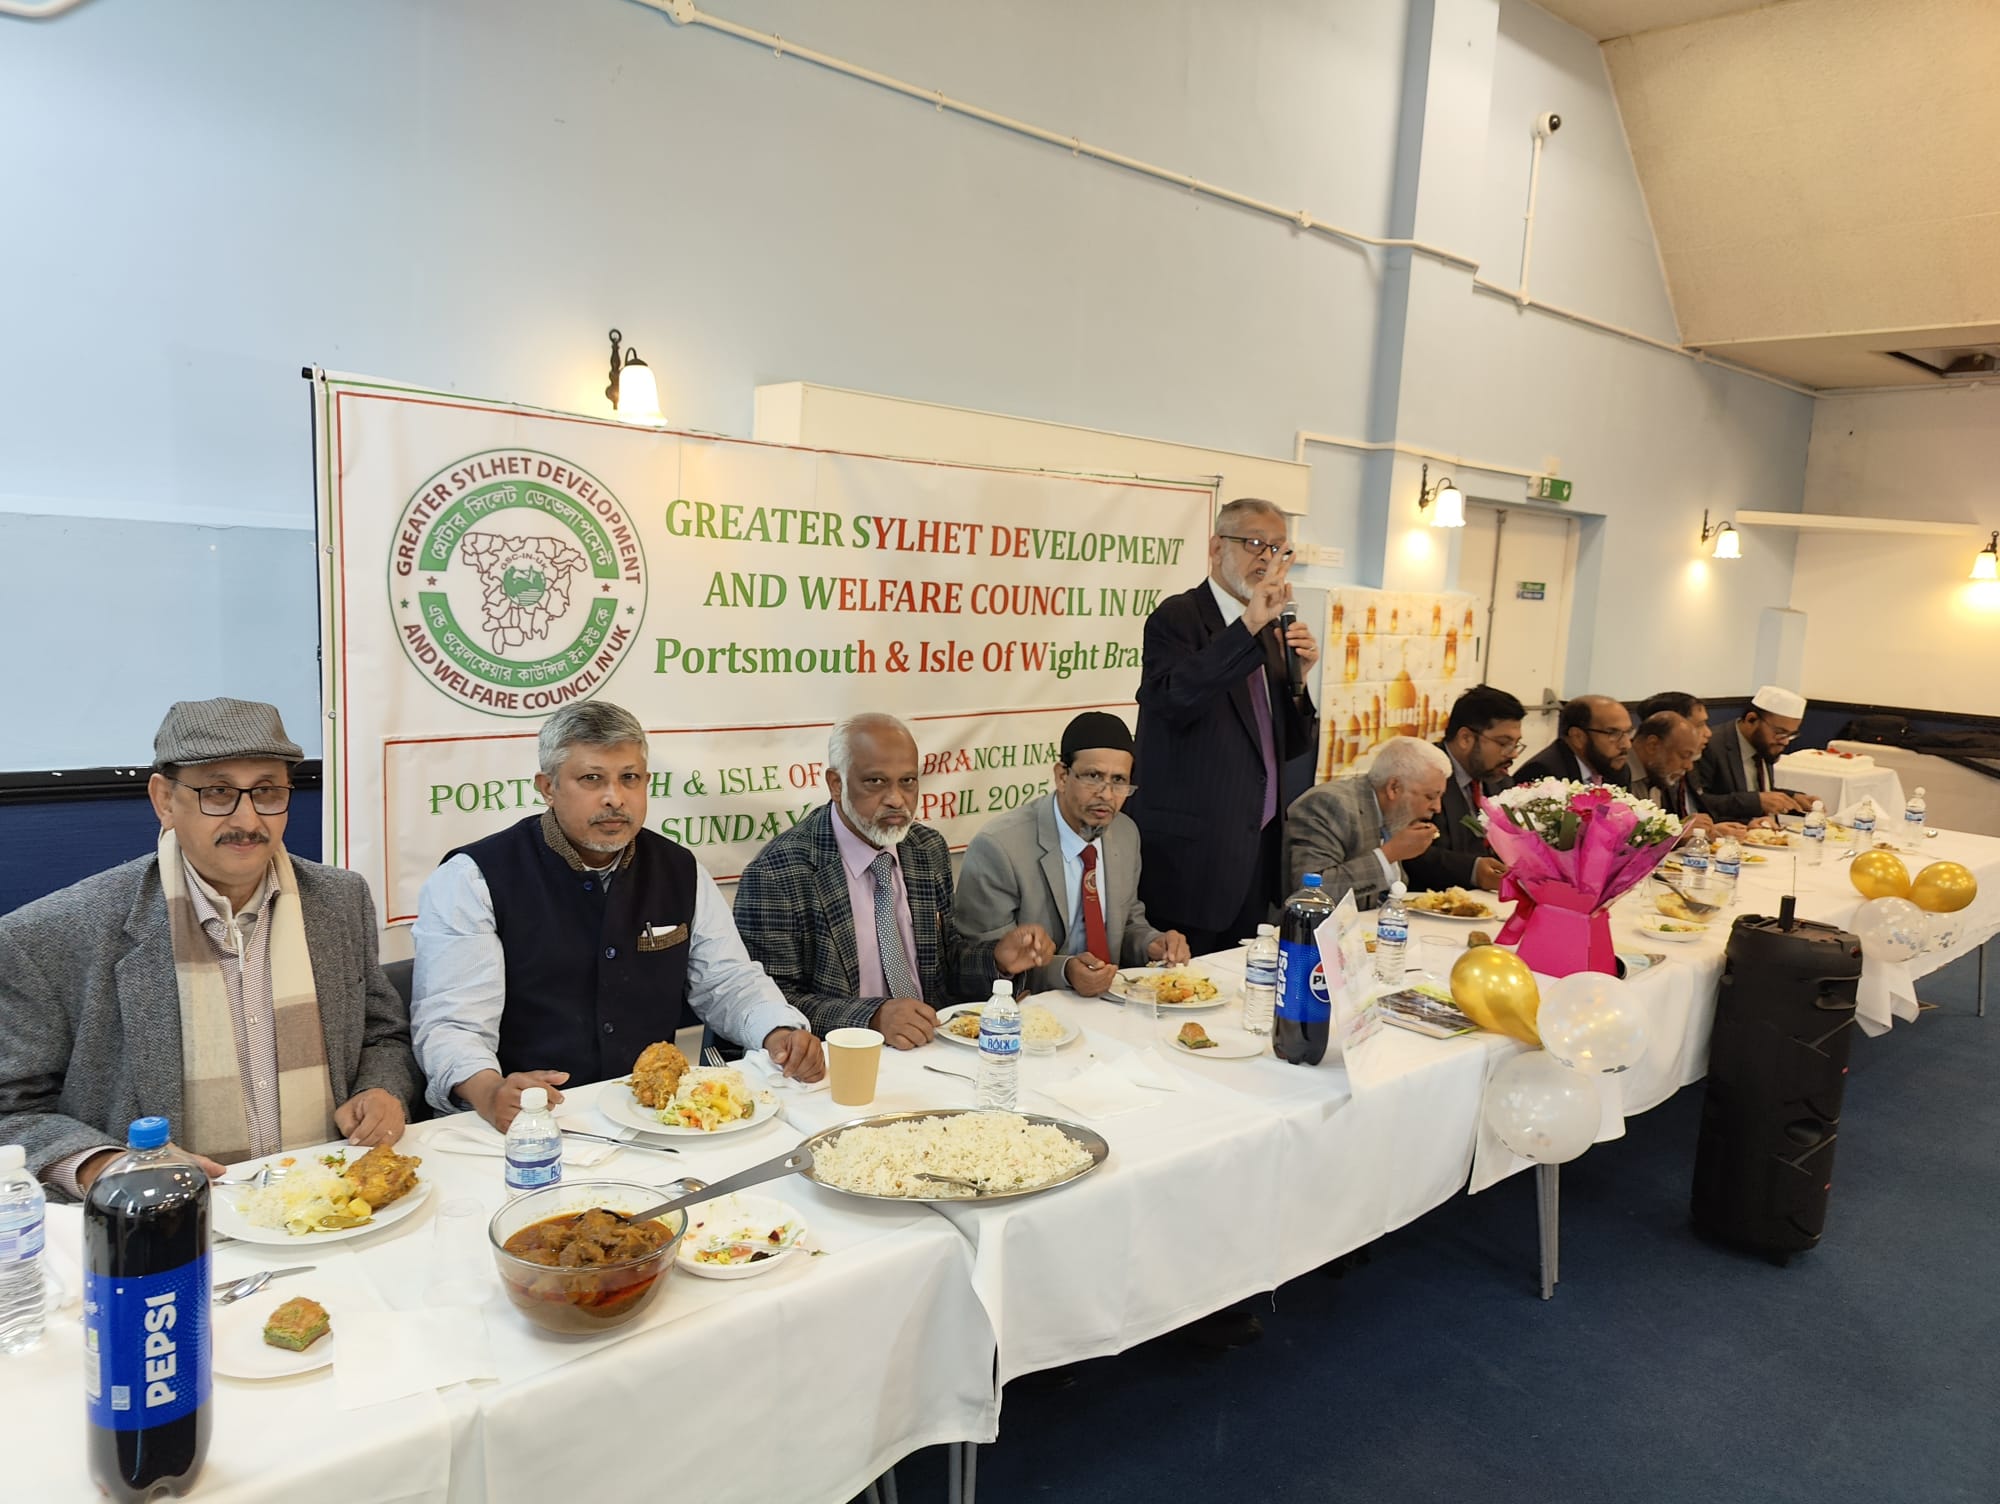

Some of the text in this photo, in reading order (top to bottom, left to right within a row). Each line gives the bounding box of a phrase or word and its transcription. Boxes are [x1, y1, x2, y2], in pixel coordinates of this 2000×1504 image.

[397, 457, 641, 584] GREATER SYLHET DEVELOPMENT
[464, 484, 518, 518] সিলেট
[665, 499, 1185, 565] GREATER SYLHET DEVELOPMENT
[703, 571, 1162, 617] AND WELFARE COUNCIL IN UK
[403, 624, 631, 709] AND WELFARE COUNCIL IN UK
[654, 638, 1143, 679] Portsmouth & Isle Of Wight Bra
[683, 769, 708, 798] &
[718, 765, 784, 795] ISLE
[788, 762, 823, 789] OF
[921, 745, 1017, 776] BRANCH
[1022, 742, 1061, 765] INA
[660, 780, 1050, 848] SUNDAY PRIL 2025
[1276, 949, 1289, 1008] PEPSI
[144, 1291, 177, 1409] PEPSI
